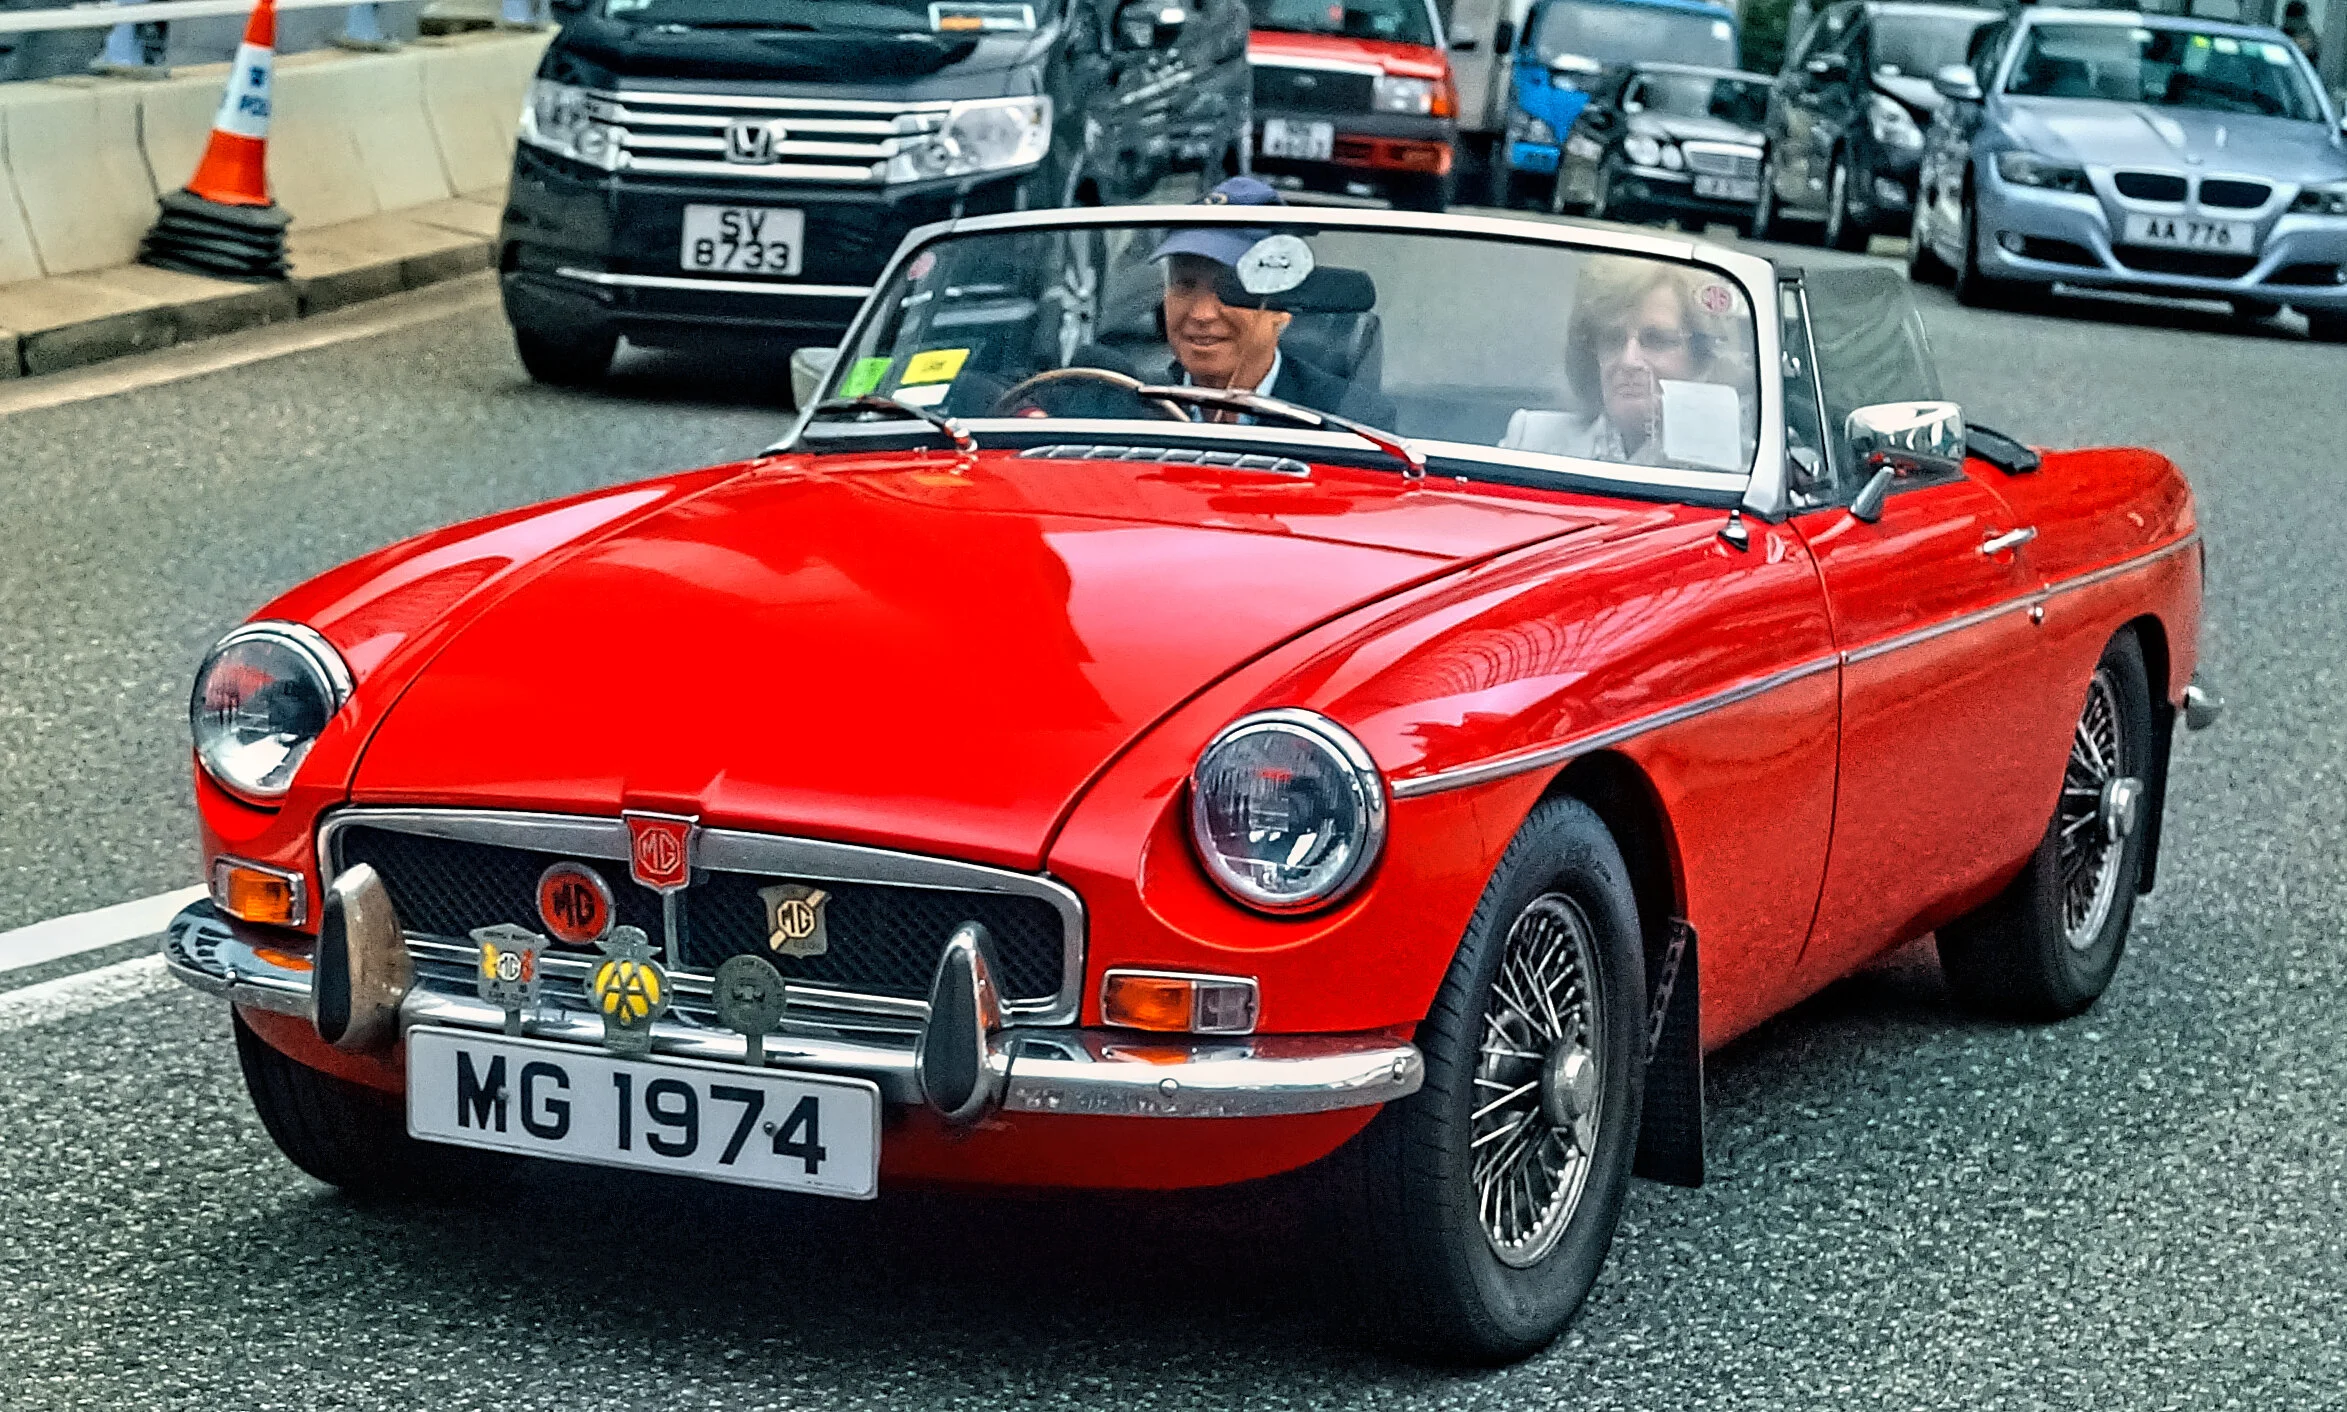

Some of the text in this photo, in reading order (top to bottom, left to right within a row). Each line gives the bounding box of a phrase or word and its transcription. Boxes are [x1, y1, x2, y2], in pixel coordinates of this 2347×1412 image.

[721, 211, 766, 240] SV
[2147, 217, 2176, 239] AA
[695, 238, 790, 270] 8733
[642, 833, 676, 870] MG
[552, 883, 595, 928] MG
[781, 902, 811, 934] MG
[456, 1050, 827, 1175] MG 1974
